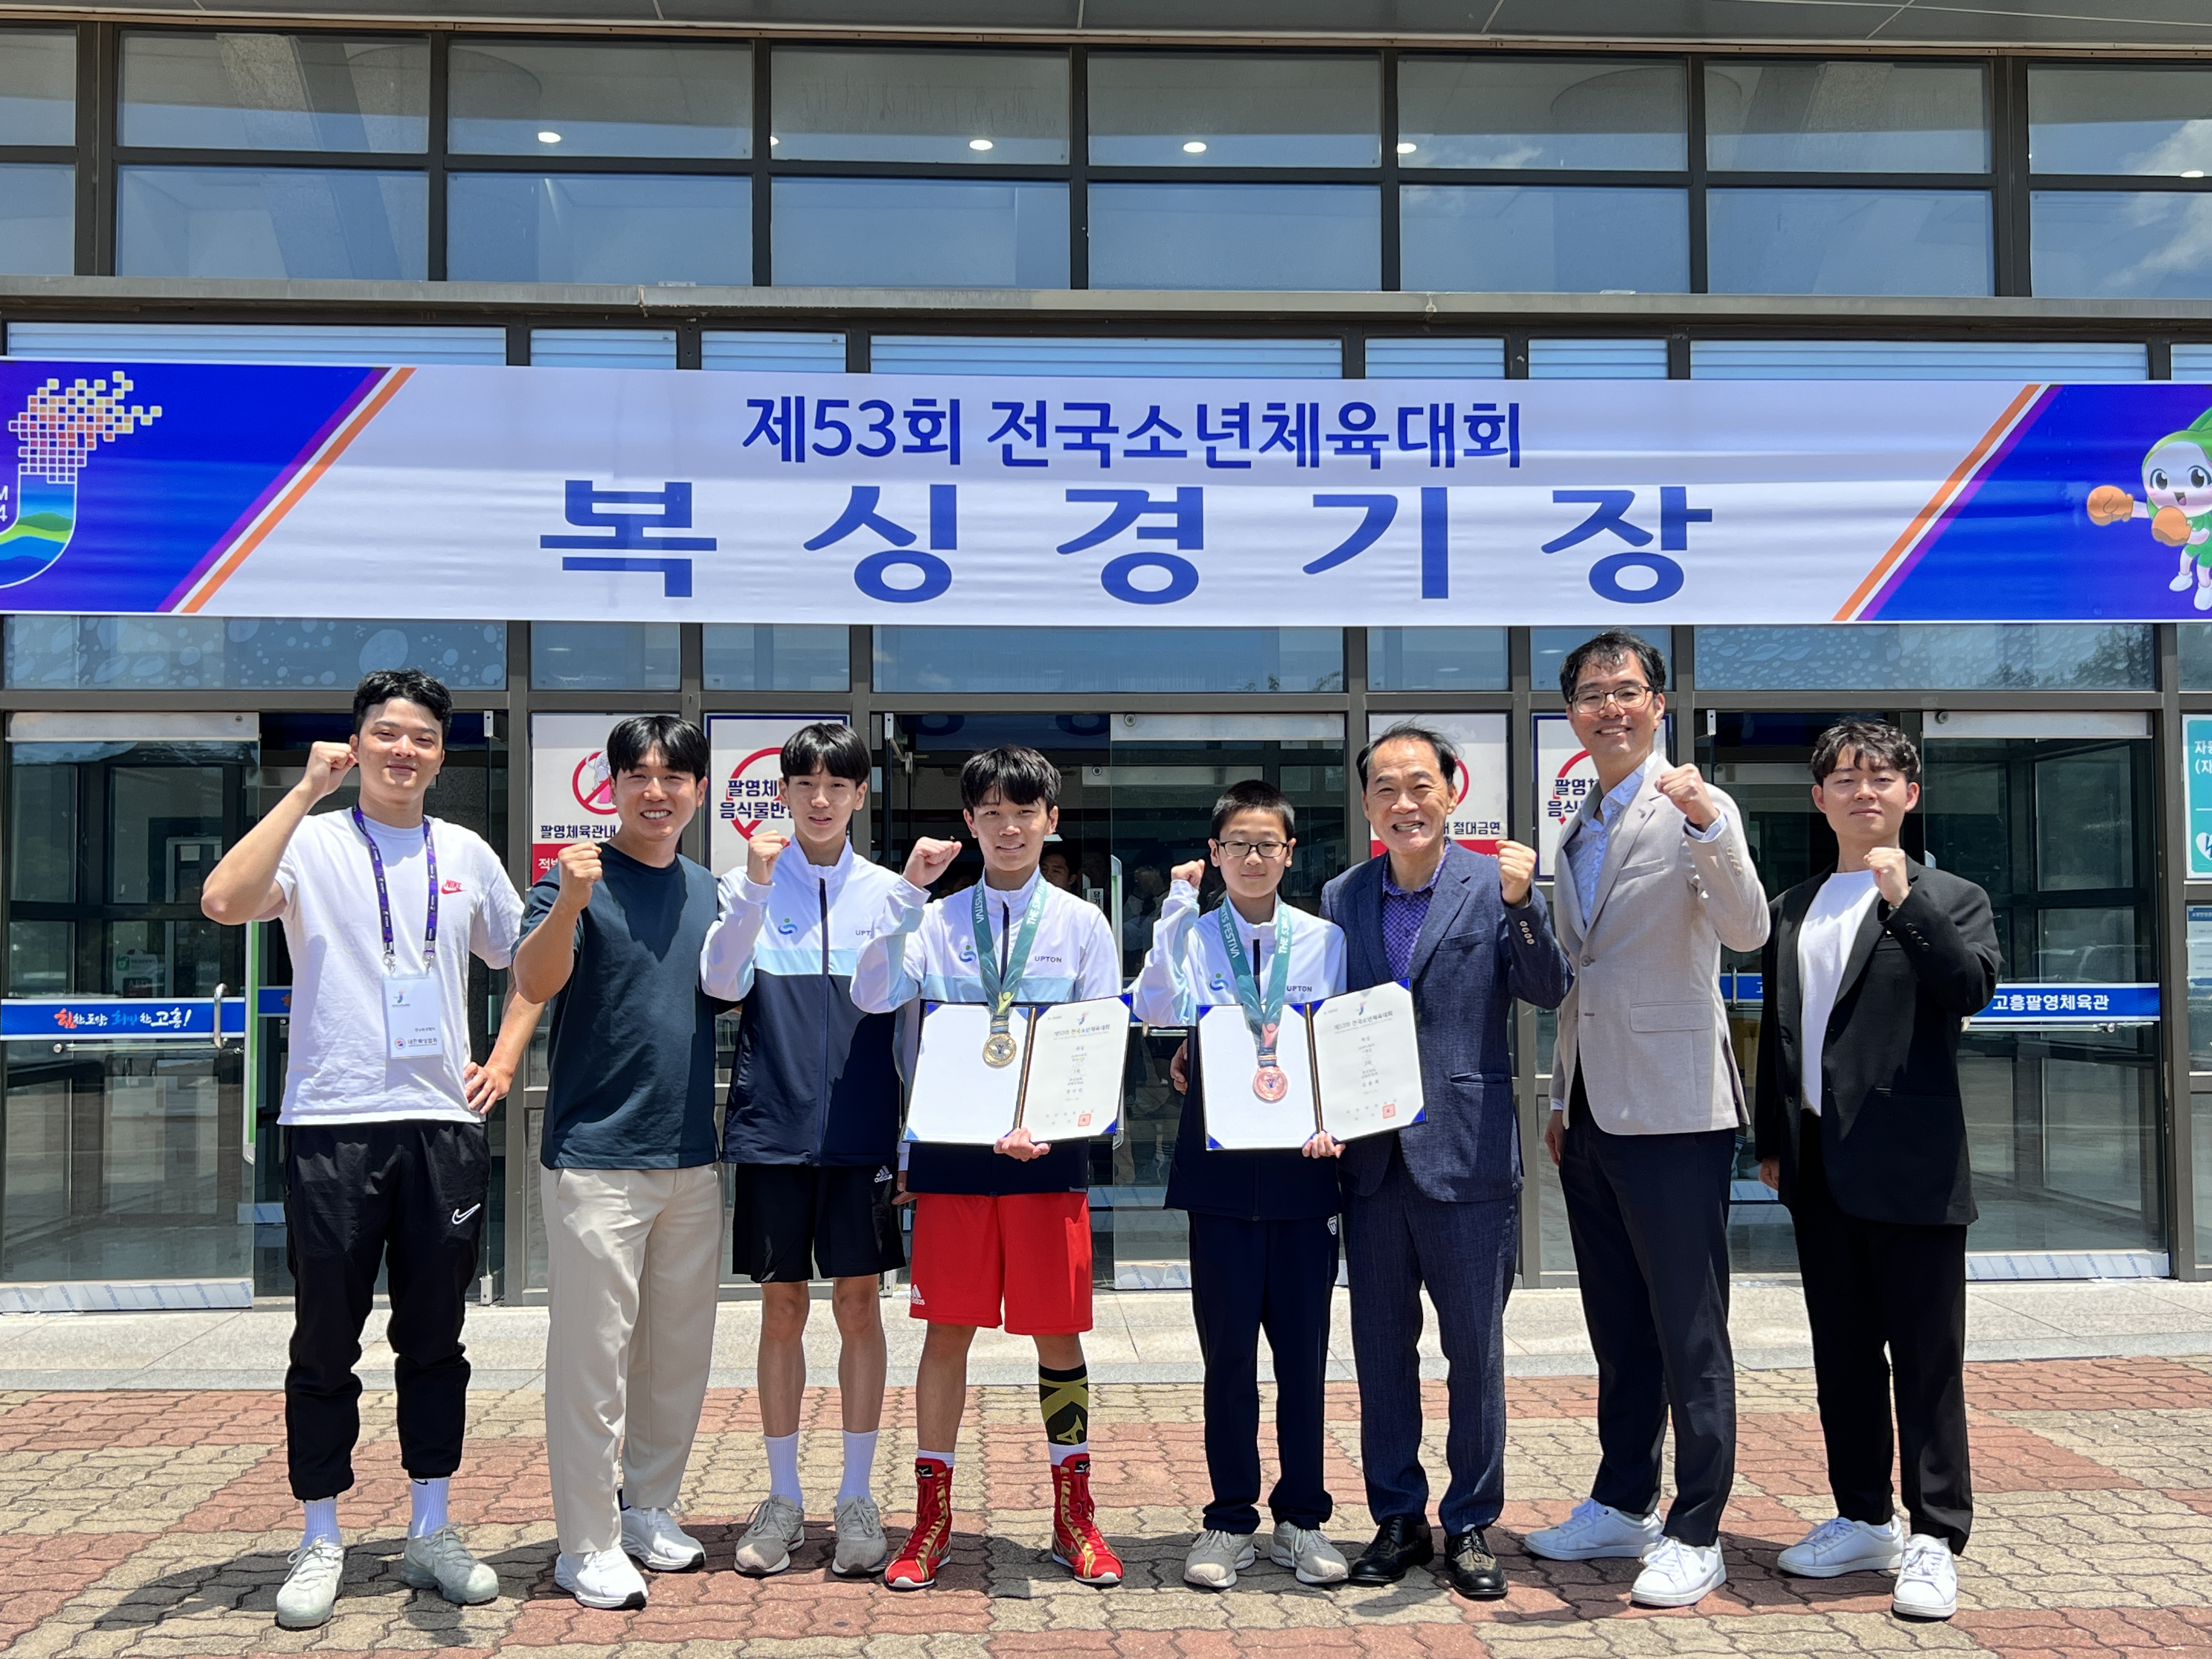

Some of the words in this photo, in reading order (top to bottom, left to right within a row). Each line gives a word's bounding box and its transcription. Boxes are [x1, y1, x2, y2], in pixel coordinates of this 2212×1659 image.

[742, 396, 961, 465] 제53회
[988, 398, 1521, 470] 전국소년체육대회
[720, 802, 793, 819] 음식물반
[540, 825, 616, 839] 팔영체육관내
[1454, 821, 1500, 834] 절대금연
[445, 879, 462, 889] NIKE
[1026, 909, 1039, 925] THE
[1278, 936, 1289, 955] THE
[1992, 994, 2109, 1011] 고흥팔영체육관
